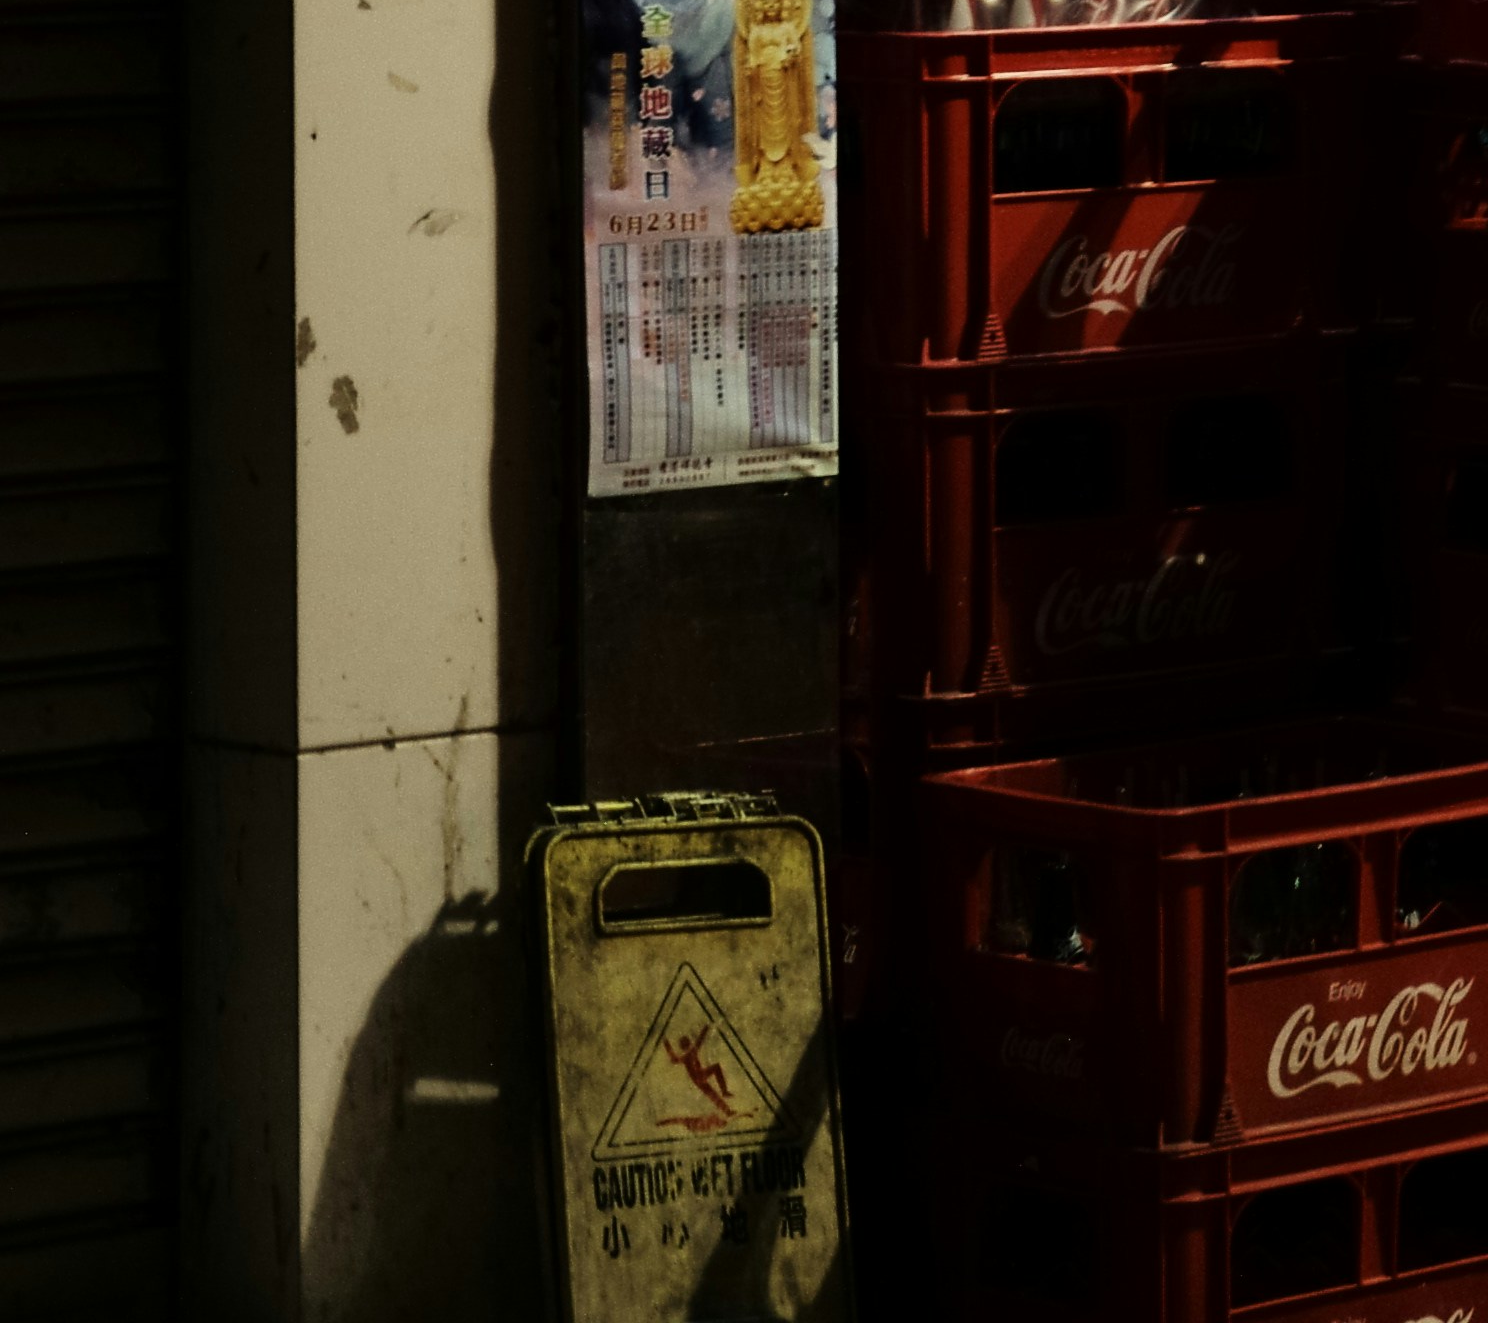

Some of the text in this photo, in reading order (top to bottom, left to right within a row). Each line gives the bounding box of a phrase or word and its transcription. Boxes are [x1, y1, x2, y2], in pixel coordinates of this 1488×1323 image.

[639, 5, 673, 201] 全球地藏日
[1267, 976, 1474, 1099] Coca-Cola
[1327, 978, 1367, 1002] Enjoy
